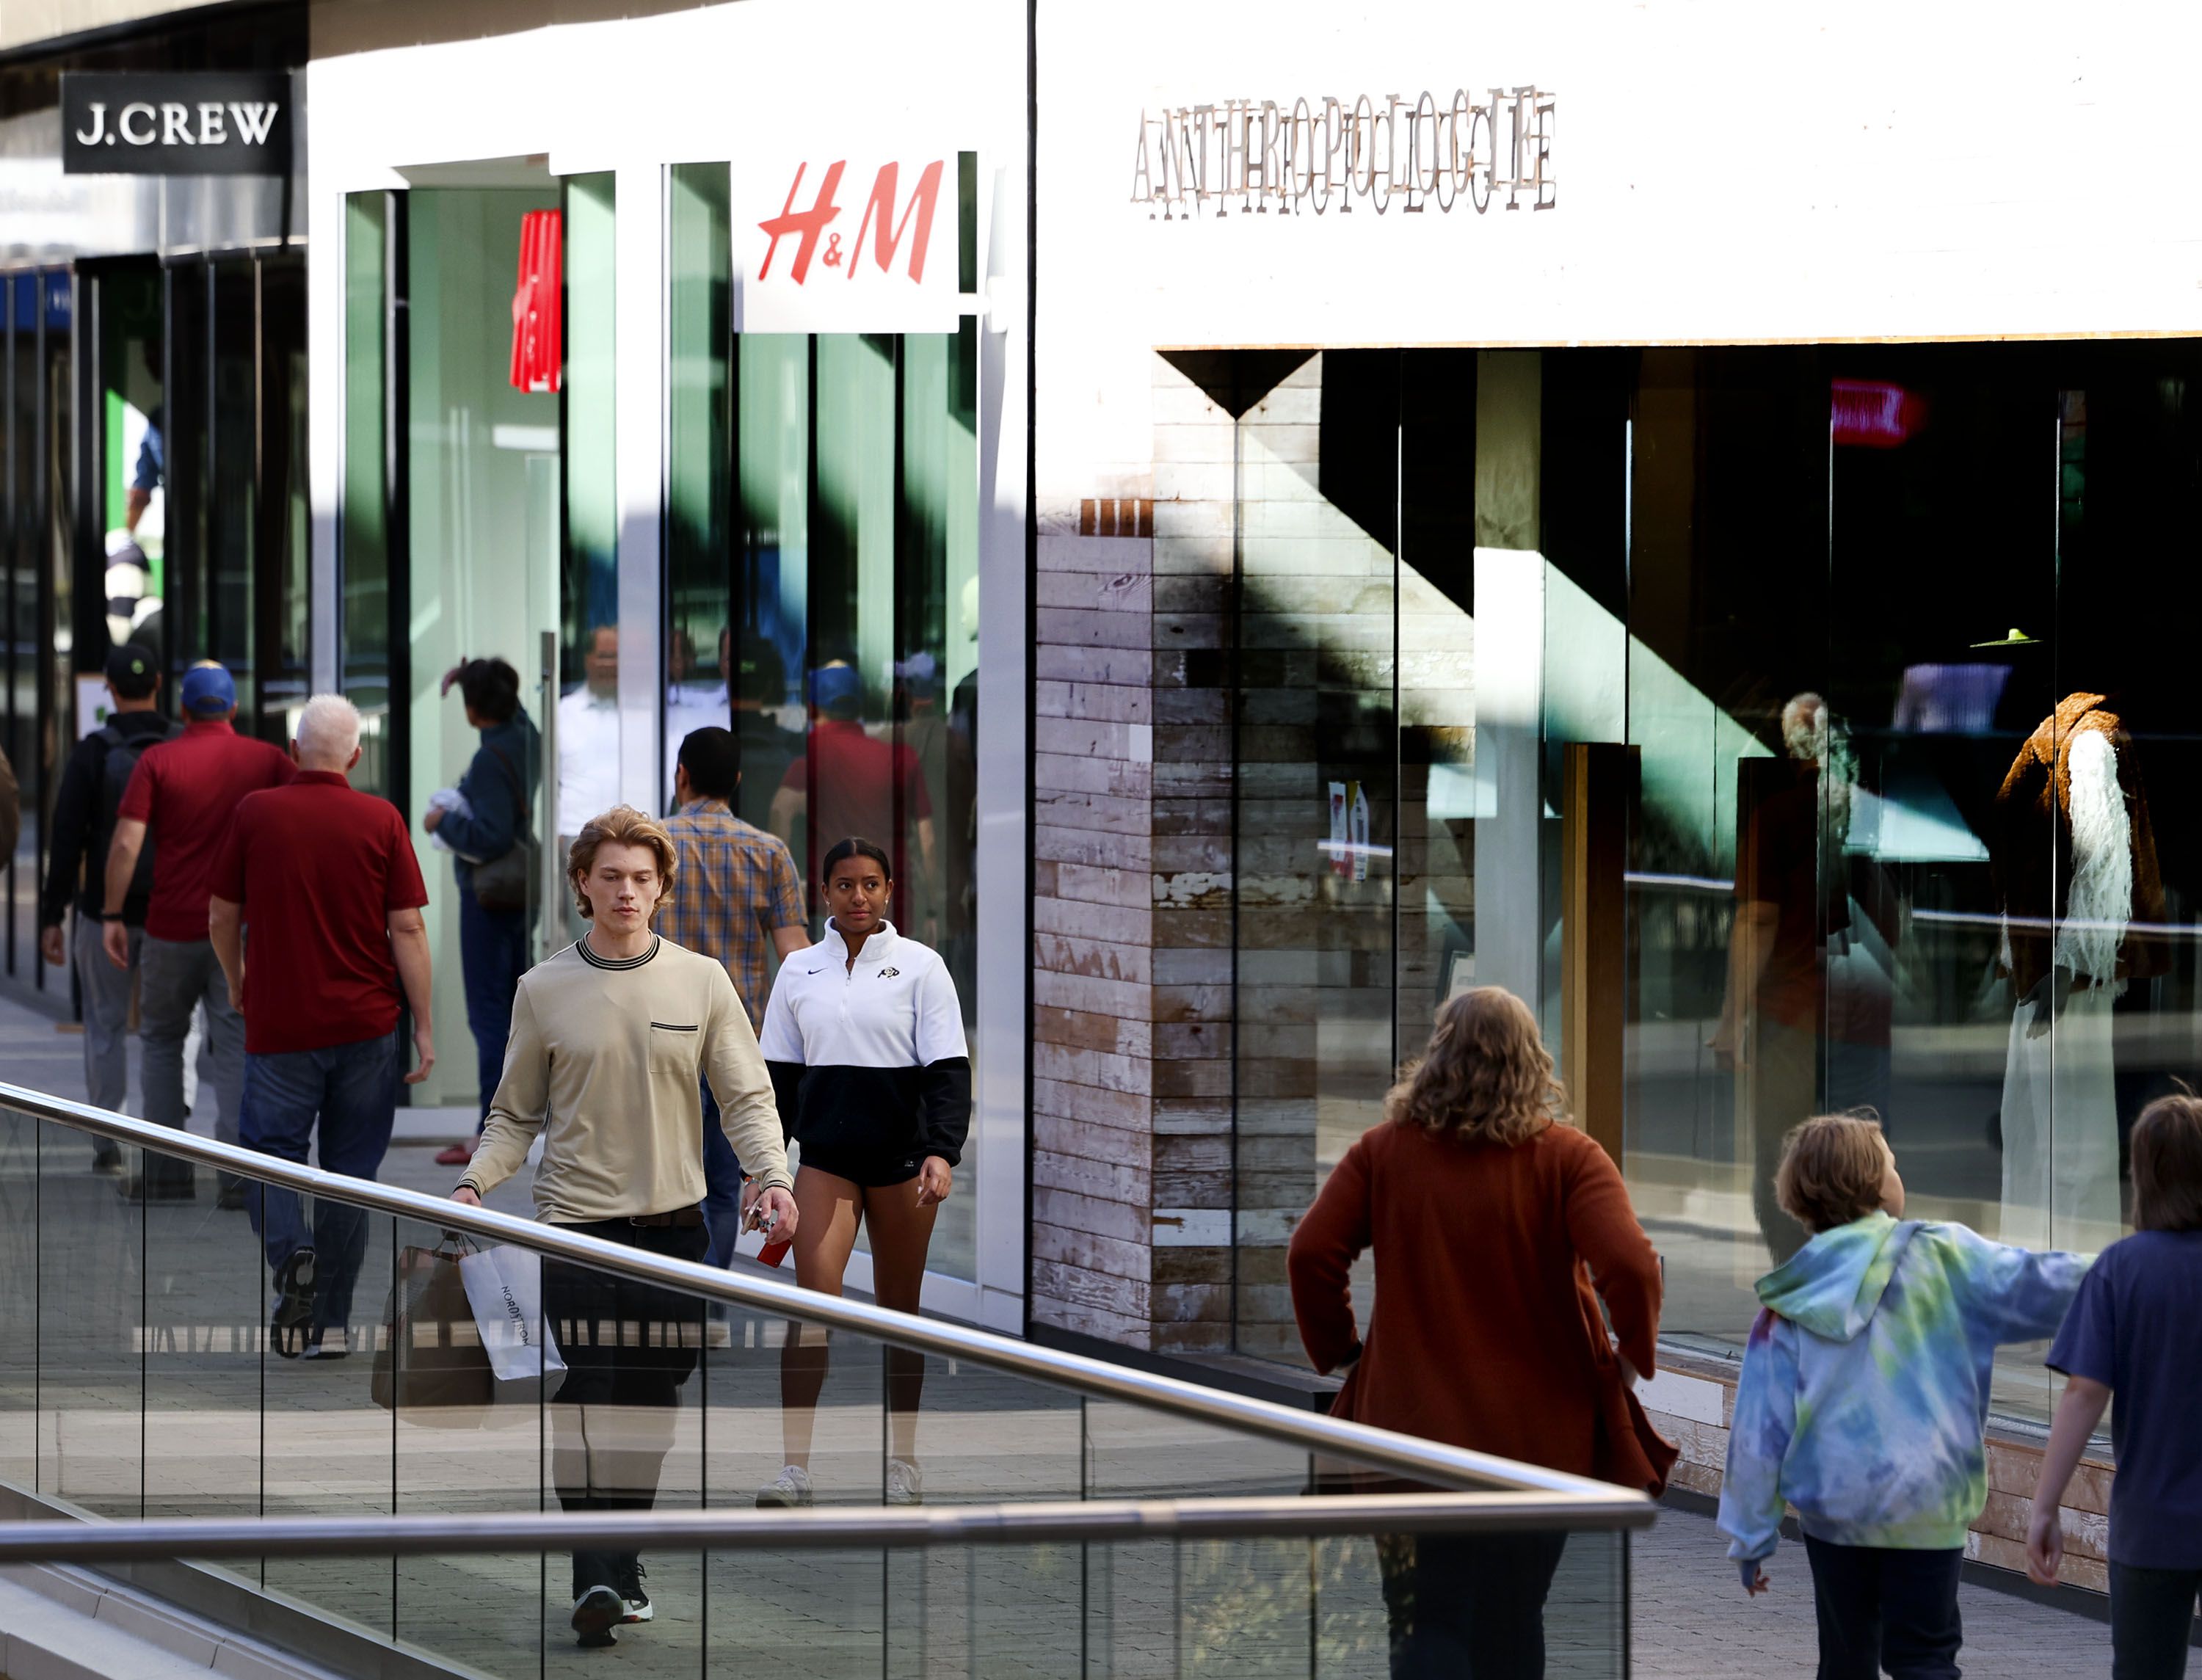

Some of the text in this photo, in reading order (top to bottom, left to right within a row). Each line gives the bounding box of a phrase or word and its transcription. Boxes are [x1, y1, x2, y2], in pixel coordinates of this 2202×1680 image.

[76, 102, 278, 145] J.CREW
[1130, 84, 1540, 206] ANTHROPOLOGIE
[757, 159, 944, 286] H&M
[501, 1286, 529, 1346] NORDSTROM
